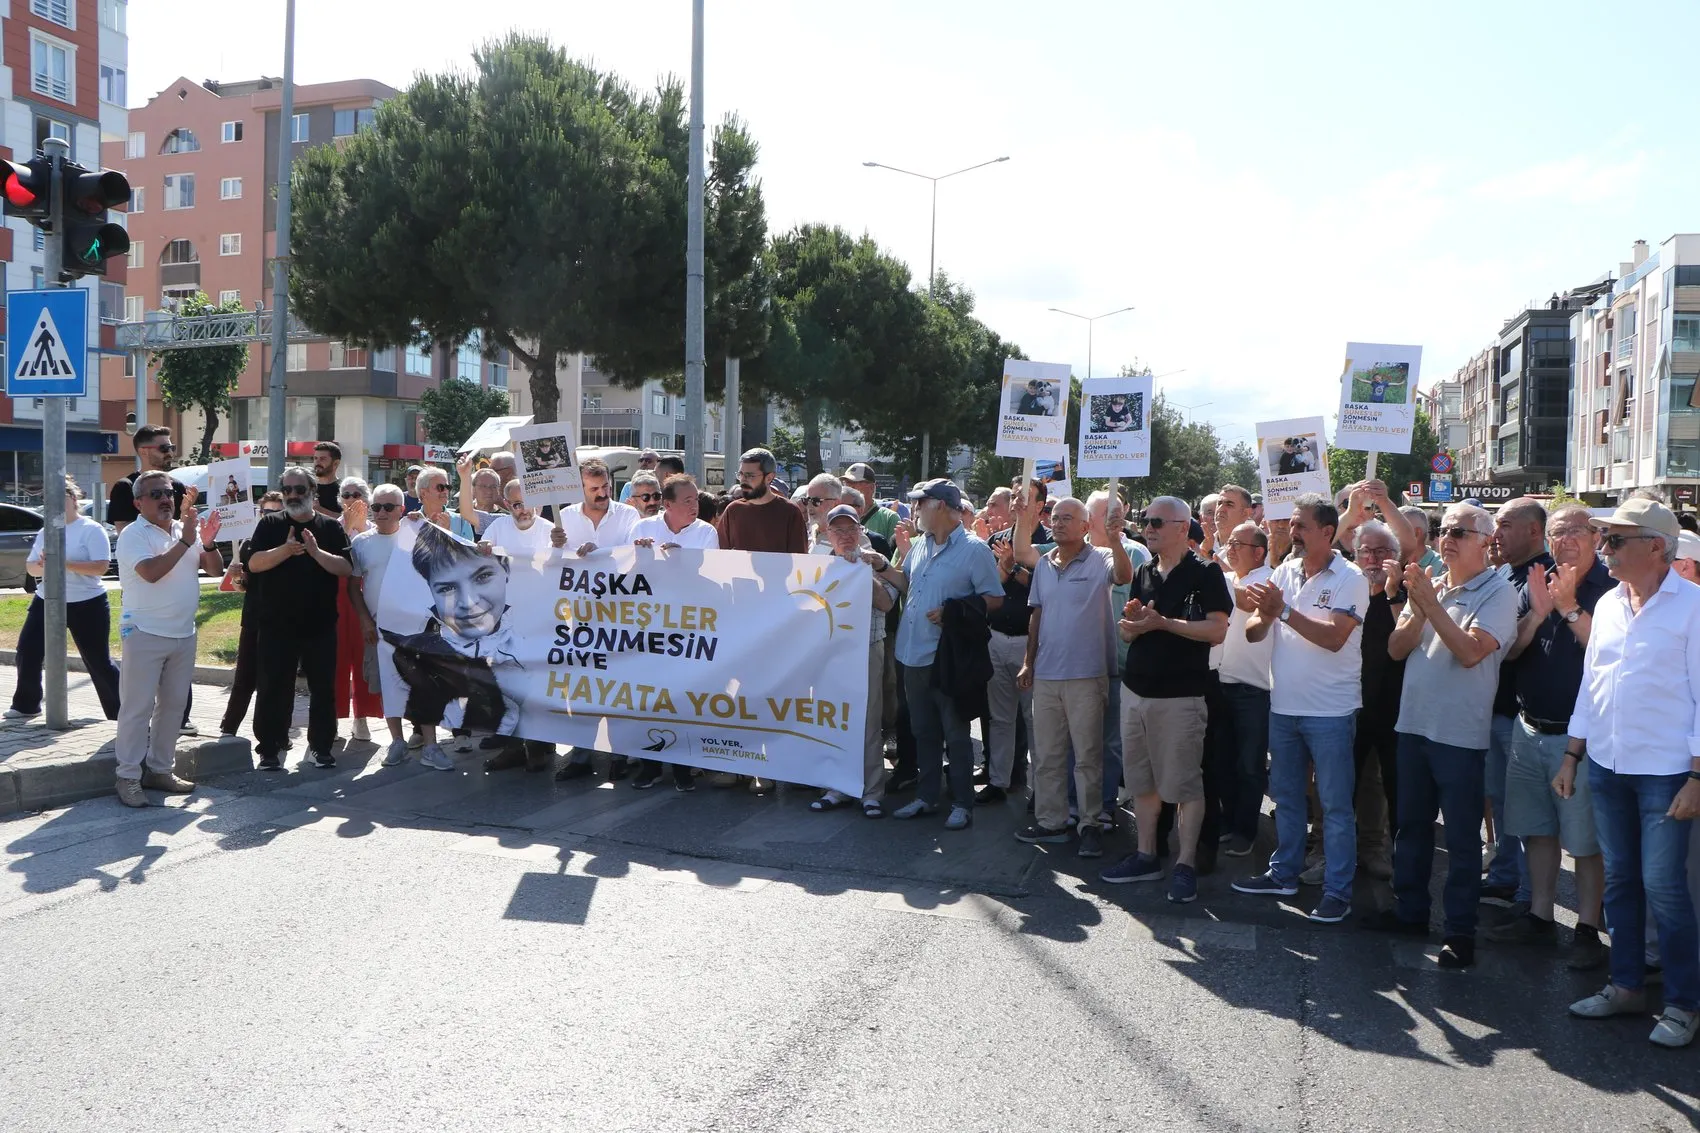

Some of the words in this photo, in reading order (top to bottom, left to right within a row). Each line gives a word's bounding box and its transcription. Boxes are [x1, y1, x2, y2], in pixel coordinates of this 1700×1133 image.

[1412, 485, 1419, 494] D
[559, 567, 653, 599] BAŞKA
[554, 622, 718, 661] SÖNMESİN
[548, 648, 608, 670] DİYE
[546, 671, 677, 714] HAYATA
[685, 691, 758, 720] YOL
[766, 698, 850, 732] VER!
[702, 746, 730, 756] HAYAT
[721, 740, 743, 748] VER,
